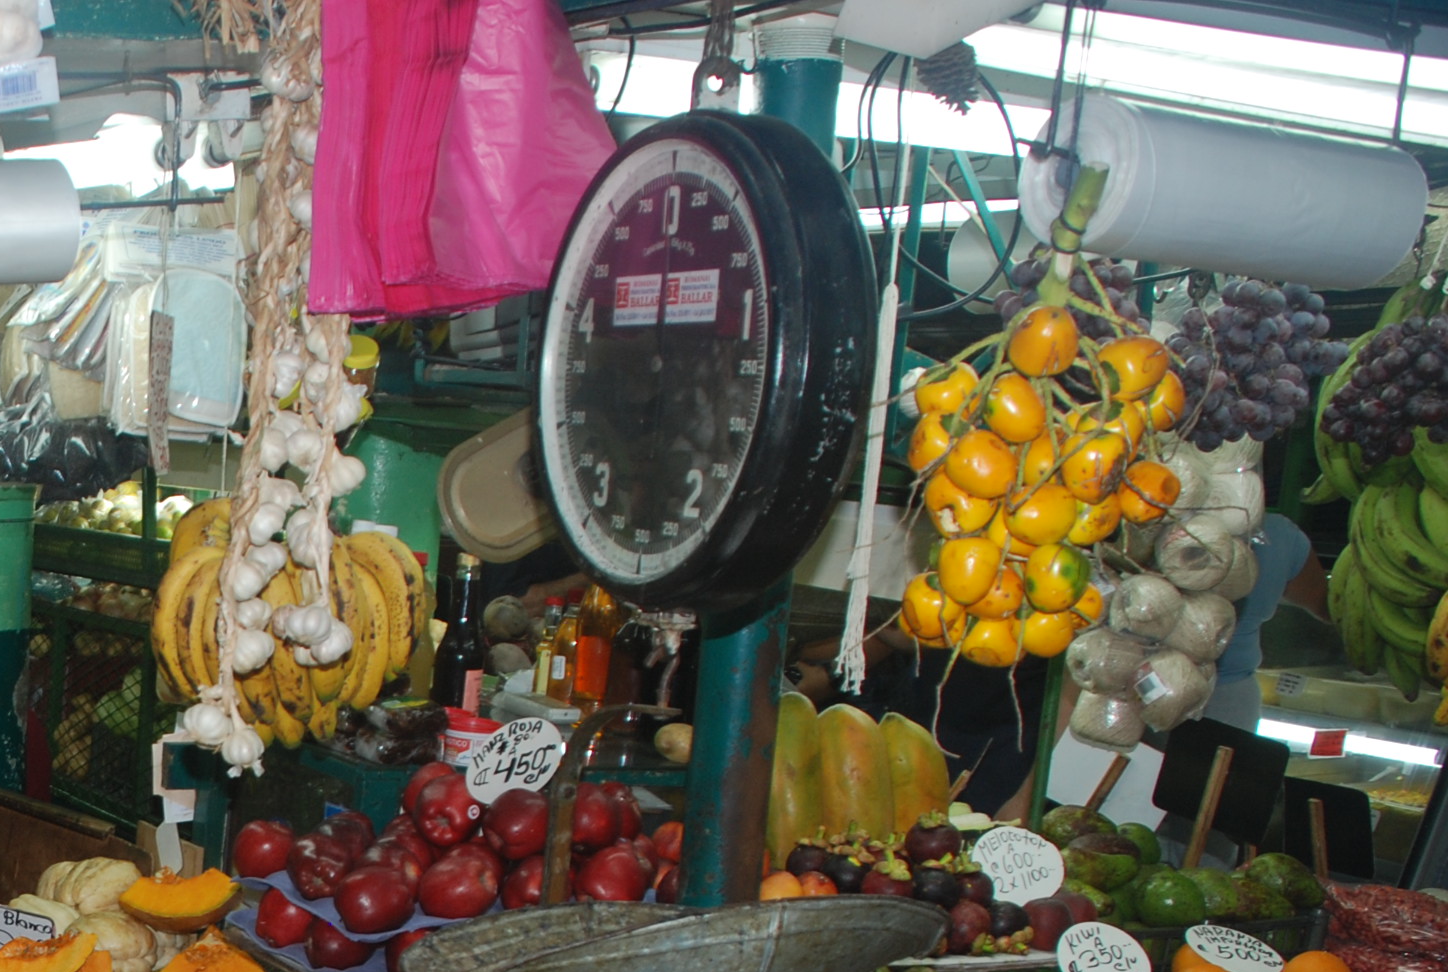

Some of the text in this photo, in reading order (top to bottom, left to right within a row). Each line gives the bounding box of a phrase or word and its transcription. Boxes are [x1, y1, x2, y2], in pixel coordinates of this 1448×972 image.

[691, 192, 709, 208] 250
[711, 215, 729, 231] 500
[614, 226, 630, 240] 500
[730, 252, 748, 268] 750
[578, 298, 595, 344] 4
[741, 288, 754, 341] 1
[739, 360, 758, 375] 250
[729, 417, 746, 431] 500
[593, 462, 610, 507] 3
[683, 469, 703, 518] 2
[662, 521, 679, 536] 250
[1094, 936, 1103, 948] A
